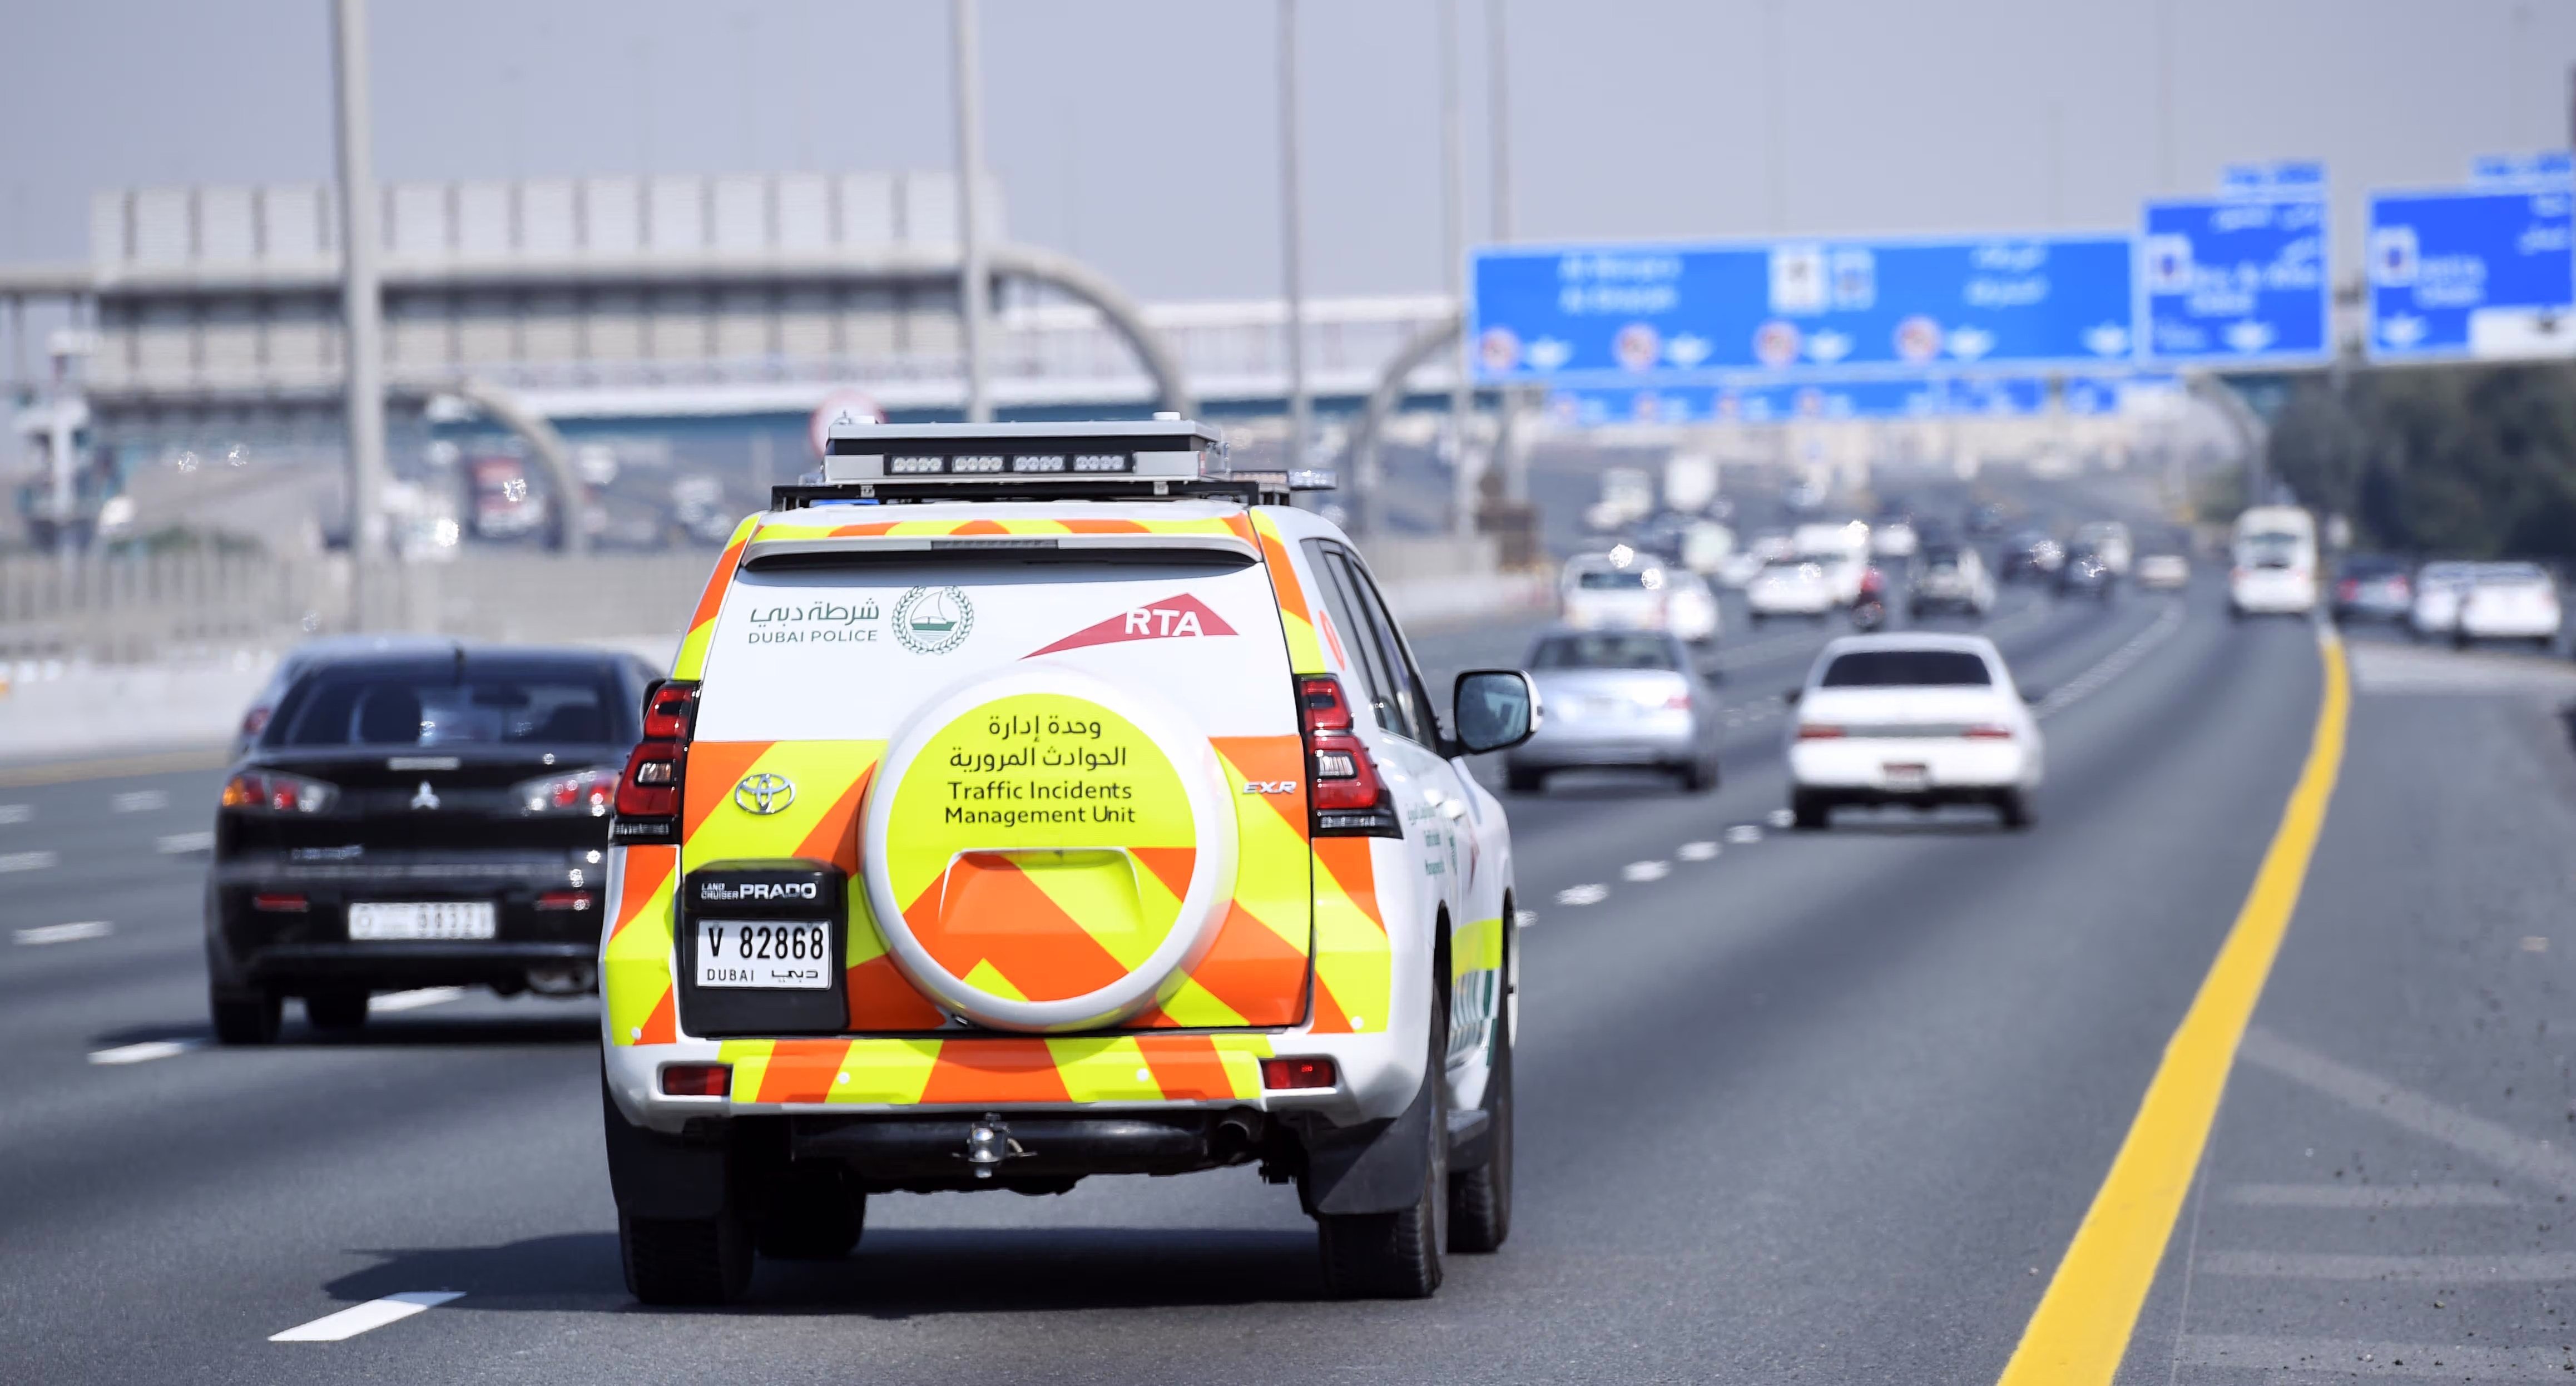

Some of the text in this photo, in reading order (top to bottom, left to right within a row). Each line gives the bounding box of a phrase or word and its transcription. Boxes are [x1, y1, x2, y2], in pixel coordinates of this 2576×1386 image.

[750, 597, 879, 627] شرطة دبي
[1124, 607, 1204, 637] RTA
[749, 630, 878, 644] DUBAI POLICE
[989, 715, 1101, 742] وحدة إدارة
[949, 746, 1126, 773] الحوادث المرورية
[947, 780, 1132, 800] Traffic Incidents
[945, 805, 1136, 827] Management Unit
[701, 883, 726, 891] LAND
[701, 890, 739, 900] CRUISER
[740, 882, 817, 900] PRADO
[708, 927, 824, 960] V 82868
[707, 968, 754, 982] DUBAI
